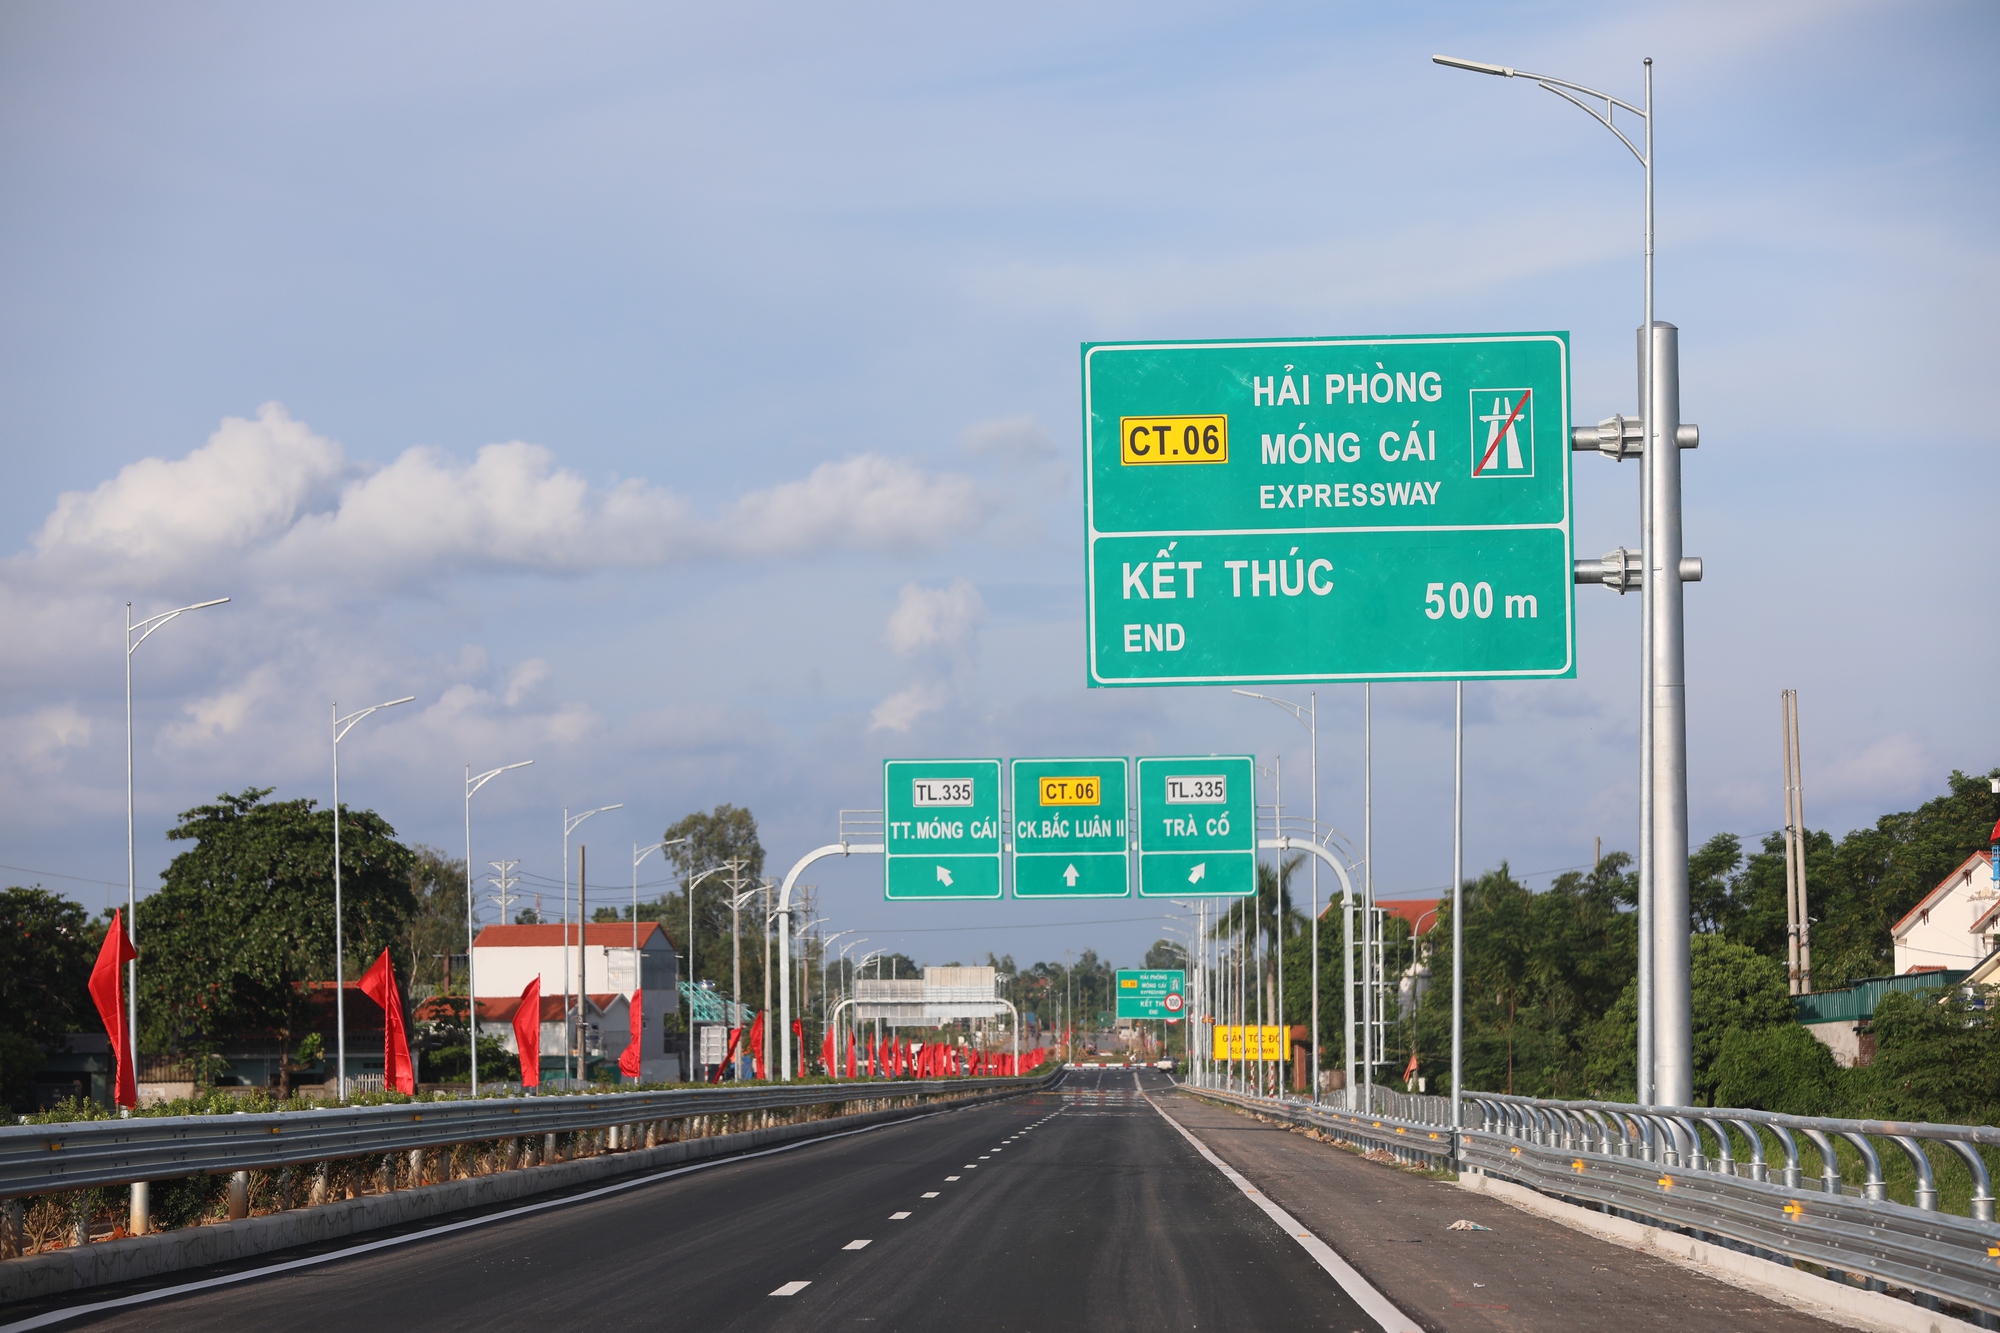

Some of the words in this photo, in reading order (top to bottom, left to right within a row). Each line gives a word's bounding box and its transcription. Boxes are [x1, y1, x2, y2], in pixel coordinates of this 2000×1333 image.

[1253, 363, 1310, 406] HẢI
[1325, 361, 1443, 404] PHÒNG
[1129, 424, 1220, 456] CT.06
[1261, 422, 1361, 465] MÓNG
[1378, 420, 1436, 462] CÁI
[1259, 481, 1442, 509] EXPRESSWAY
[1122, 541, 1203, 600] KẾT
[1224, 546, 1334, 598] THÚC
[1424, 581, 1494, 620] 500
[1504, 594, 1538, 619] m
[1123, 623, 1186, 653] END
[916, 784, 971, 801] TL.335
[1046, 783, 1094, 800] CT.06
[1168, 781, 1223, 798] TL.335
[889, 816, 964, 840] TT.MÓNG
[970, 815, 997, 839] CÁI
[1017, 811, 1070, 838] CK.BẮC
[1075, 814, 1112, 838] LUÂN
[1116, 819, 1125, 837] II
[1162, 813, 1199, 837] TRÀ
